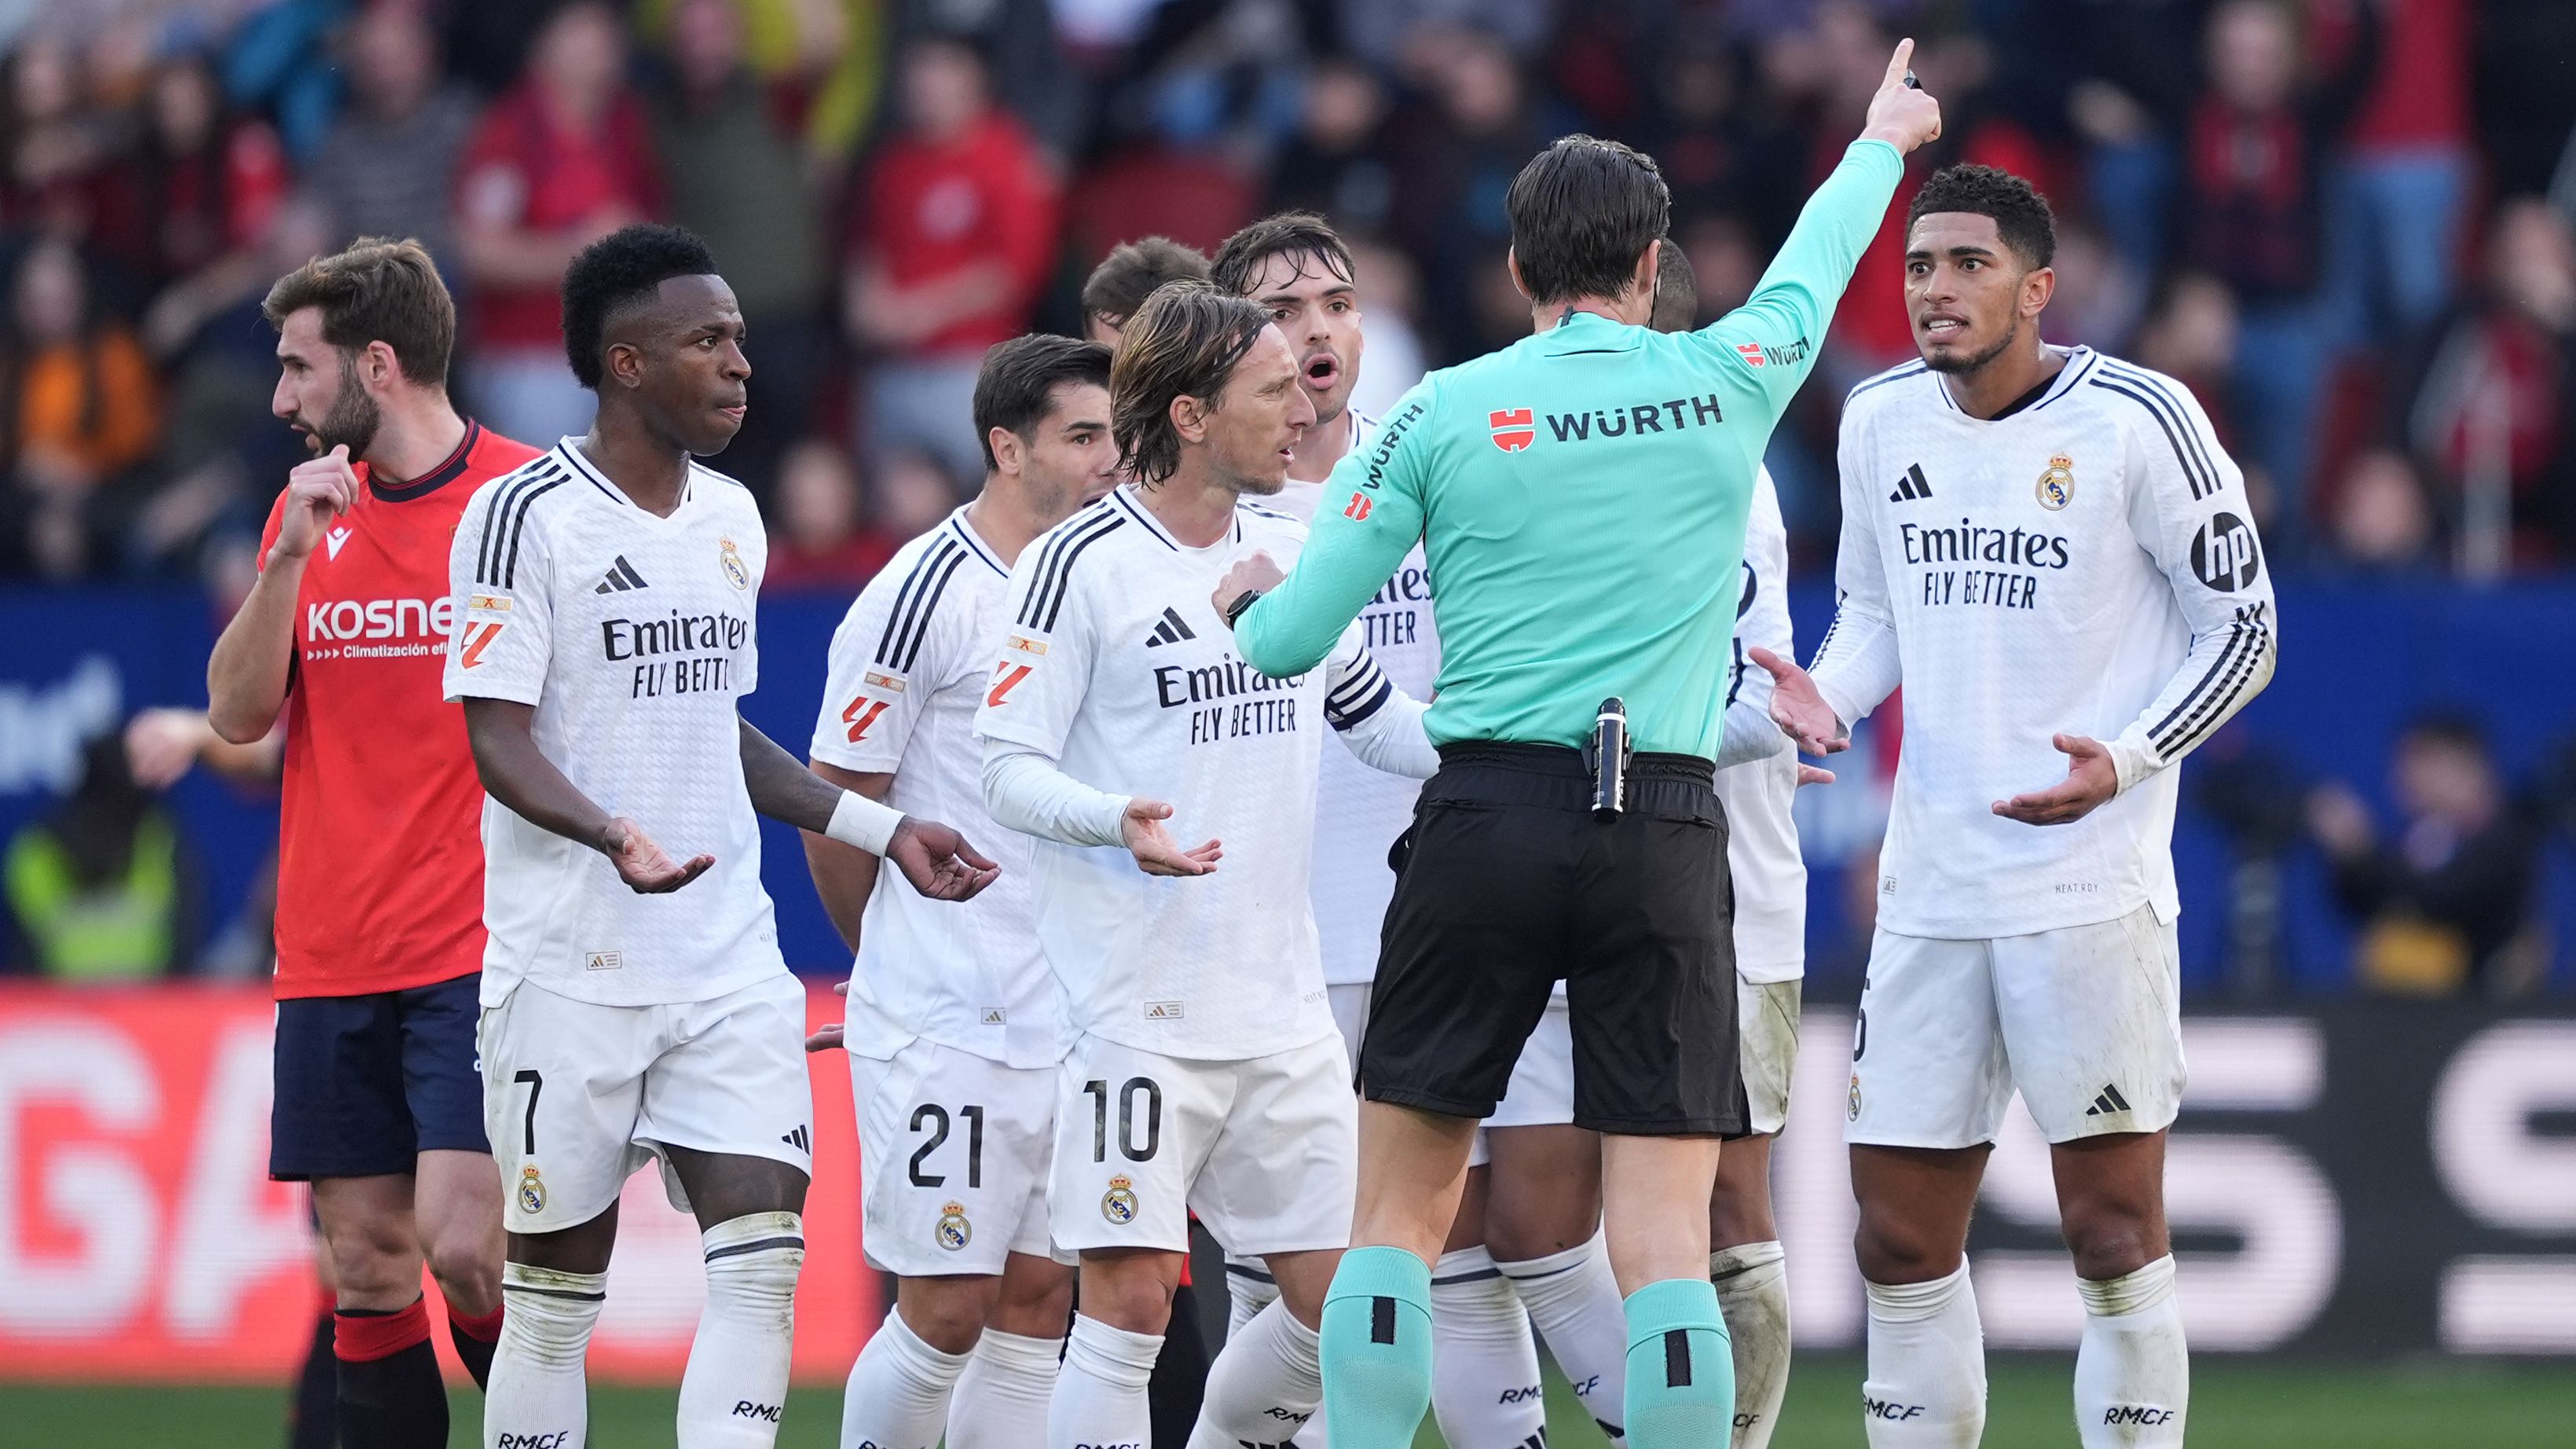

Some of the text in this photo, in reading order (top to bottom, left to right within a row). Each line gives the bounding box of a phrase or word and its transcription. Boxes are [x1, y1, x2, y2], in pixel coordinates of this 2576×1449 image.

[1545, 393, 1723, 442] WÜRTH
[1361, 403, 1424, 491] WÜRTH
[1900, 517, 2068, 569] Emirates
[2203, 514, 2252, 592] hp
[1925, 570, 2036, 609] FLY BETTER
[1358, 611, 1416, 648] TTER
[343, 644, 428, 658] Climatización
[632, 662, 667, 699] FLY
[1191, 699, 1296, 745] FLY BETTER
[514, 1069, 543, 1155] 7
[1083, 1077, 1162, 1163] 10
[909, 1103, 984, 1188] 21
[732, 1400, 782, 1423] RMC
[1863, 1393, 1926, 1421] MCF
[2104, 1406, 2175, 1425] RMCF
[498, 1430, 569, 1449] RMCF
